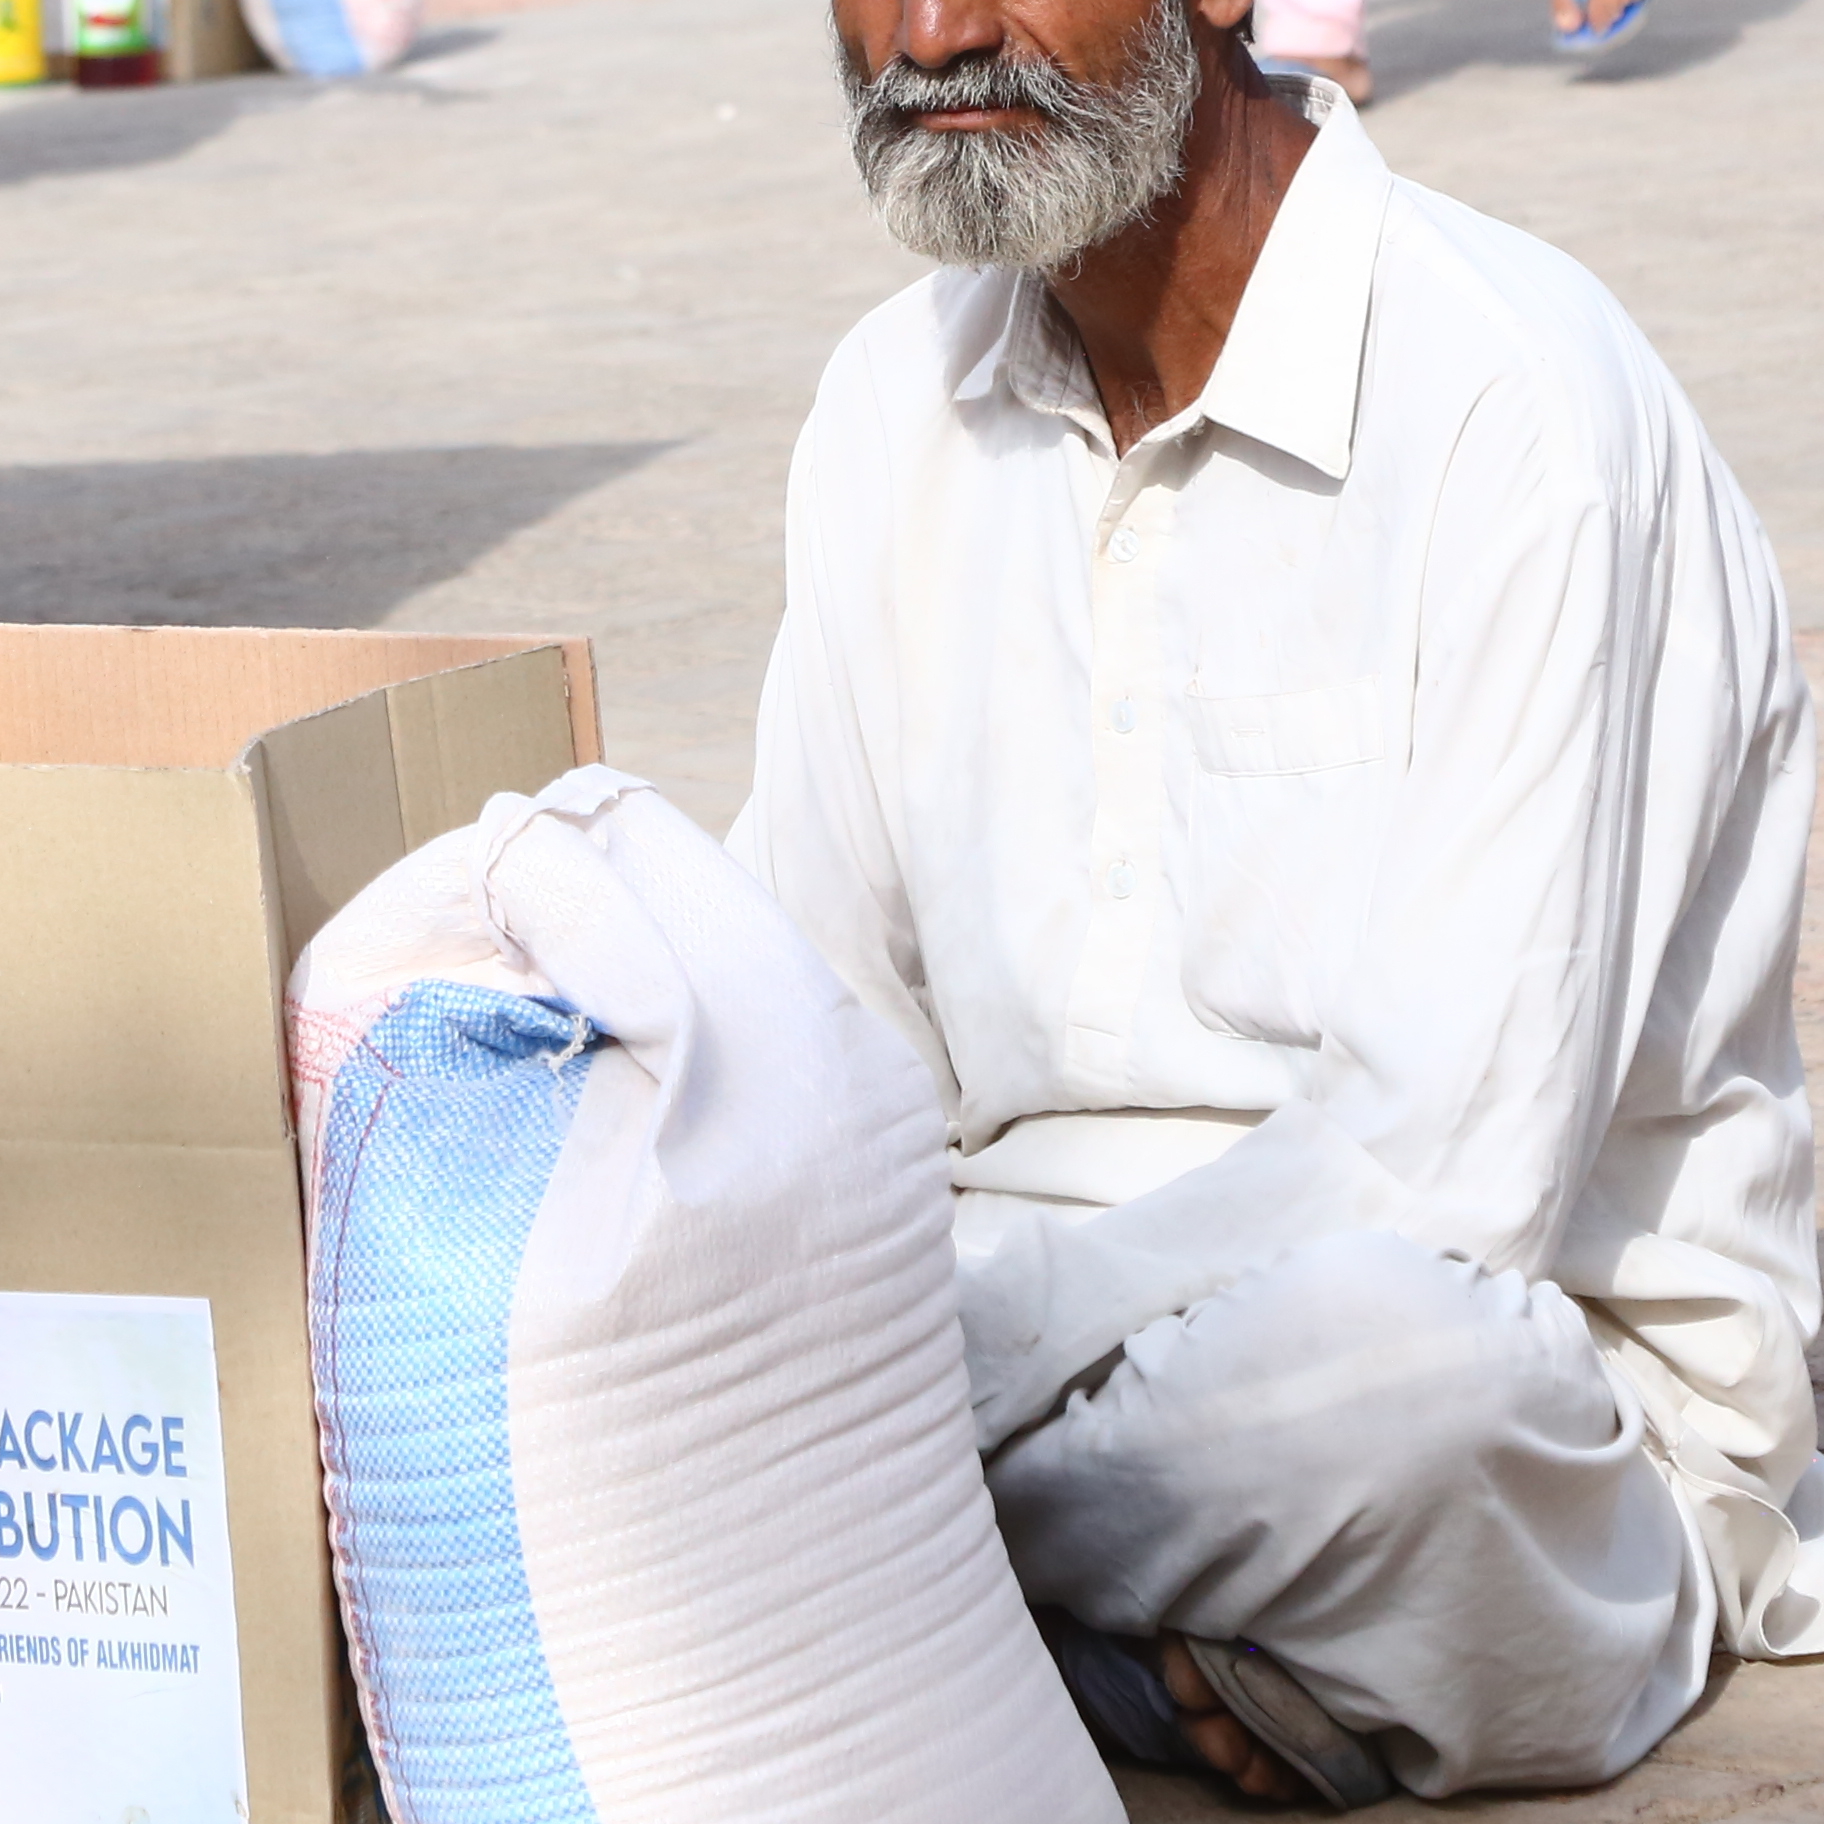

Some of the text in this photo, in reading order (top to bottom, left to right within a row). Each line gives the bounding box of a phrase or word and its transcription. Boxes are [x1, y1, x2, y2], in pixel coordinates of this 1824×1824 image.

[53, 1578, 168, 1617] PAKISTAN
[66, 1636, 90, 1668] OF
[96, 1639, 201, 1674] ALKHIDMAT
